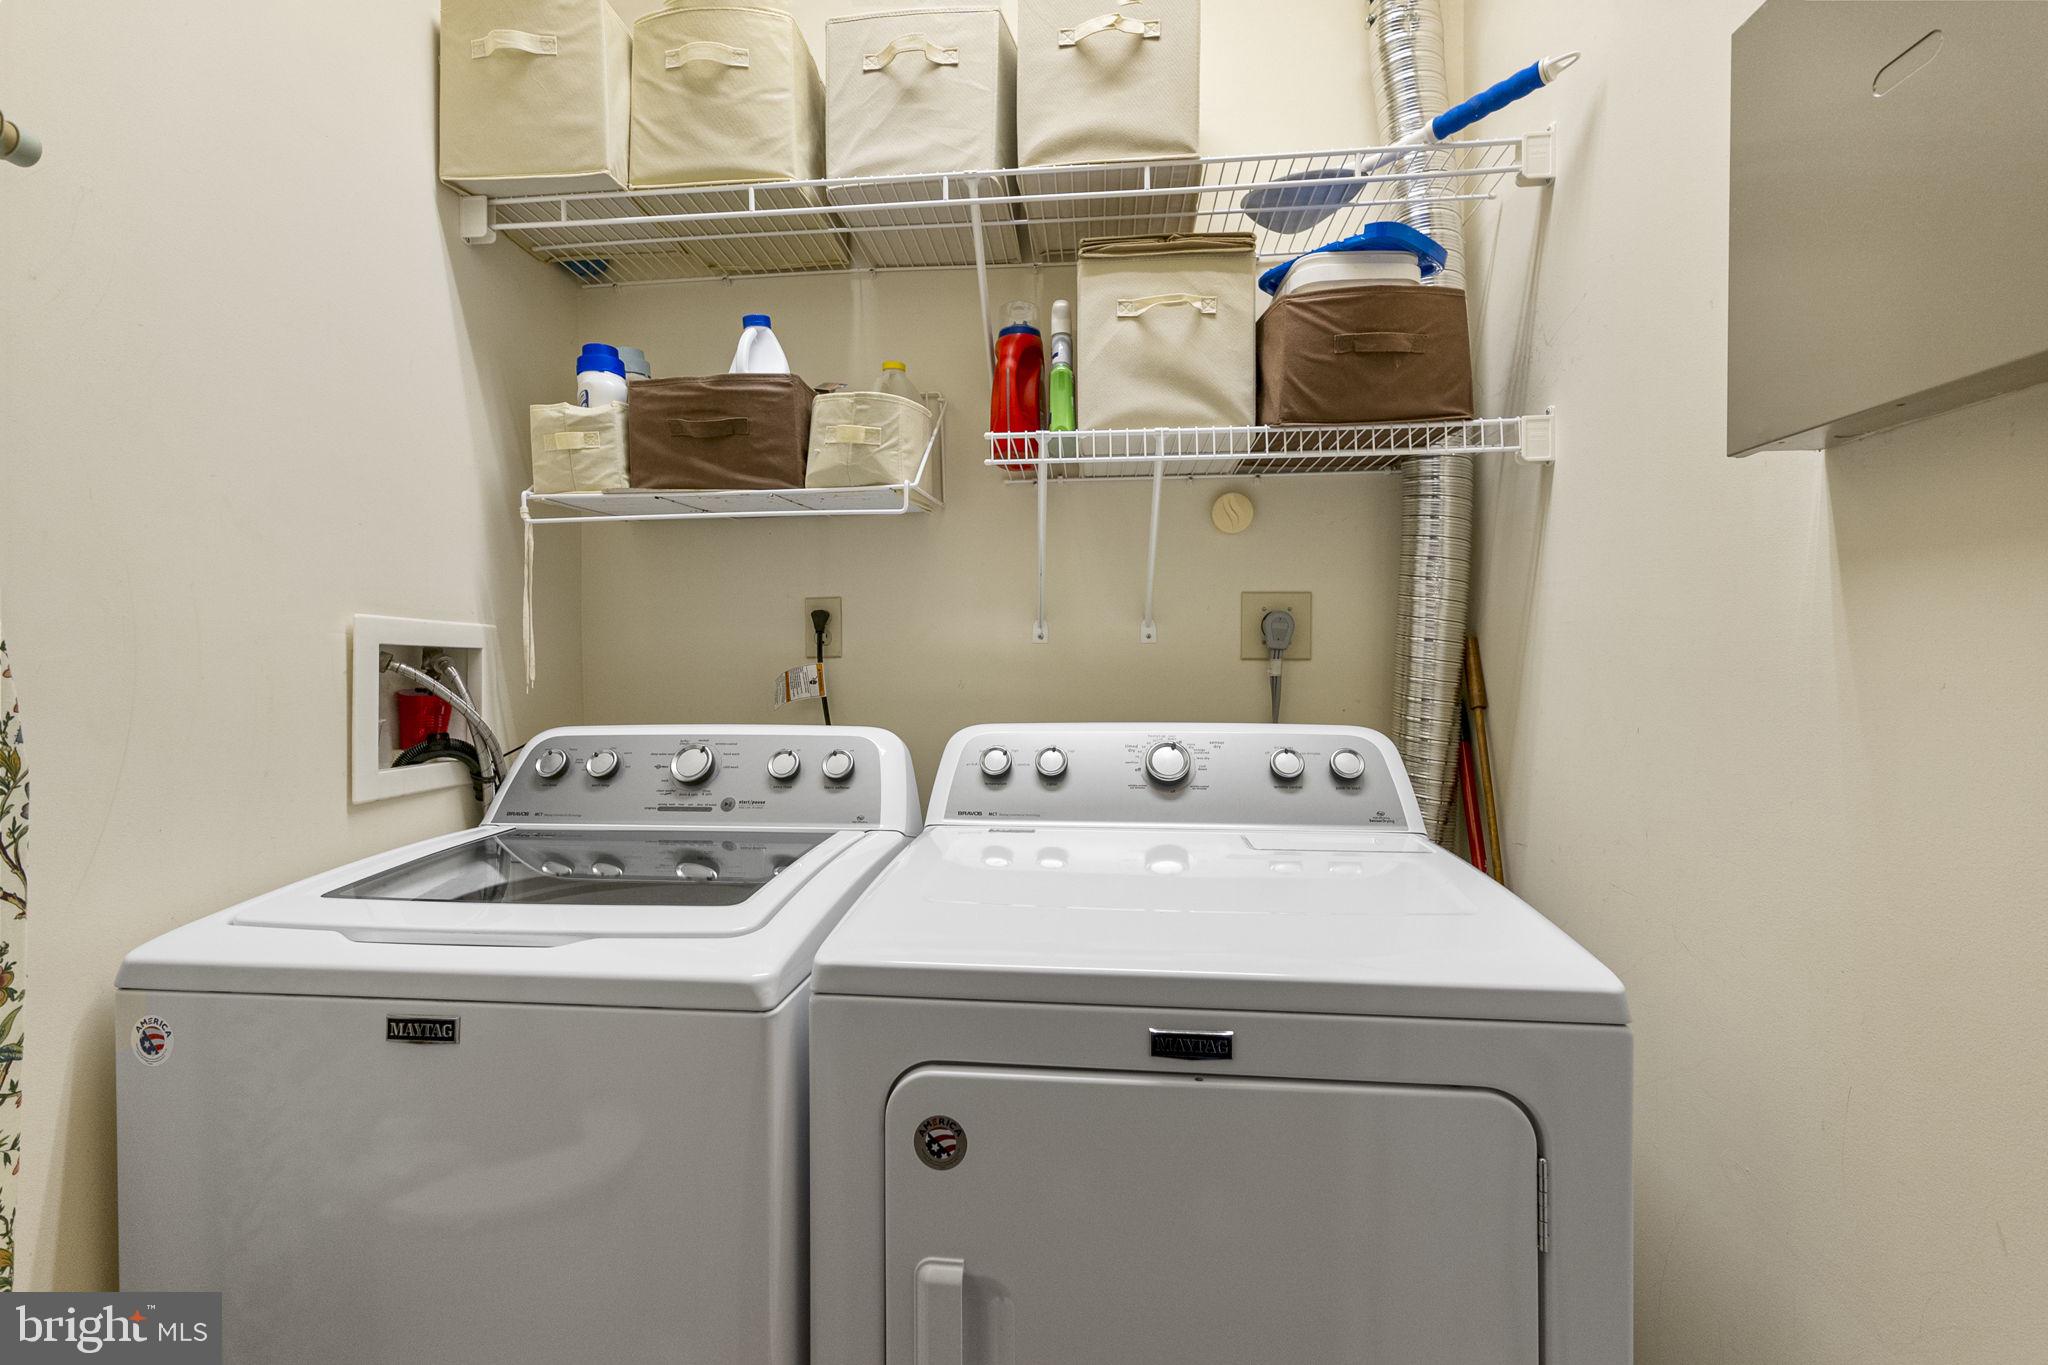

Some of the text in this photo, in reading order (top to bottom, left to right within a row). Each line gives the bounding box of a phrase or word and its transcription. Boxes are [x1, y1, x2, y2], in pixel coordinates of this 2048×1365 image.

[135, 1017, 172, 1039] AMERICA
[389, 1022, 453, 1038] MAYTAG
[1155, 1037, 1229, 1054] MAYTAG
[918, 1117, 962, 1138] AMERICA
